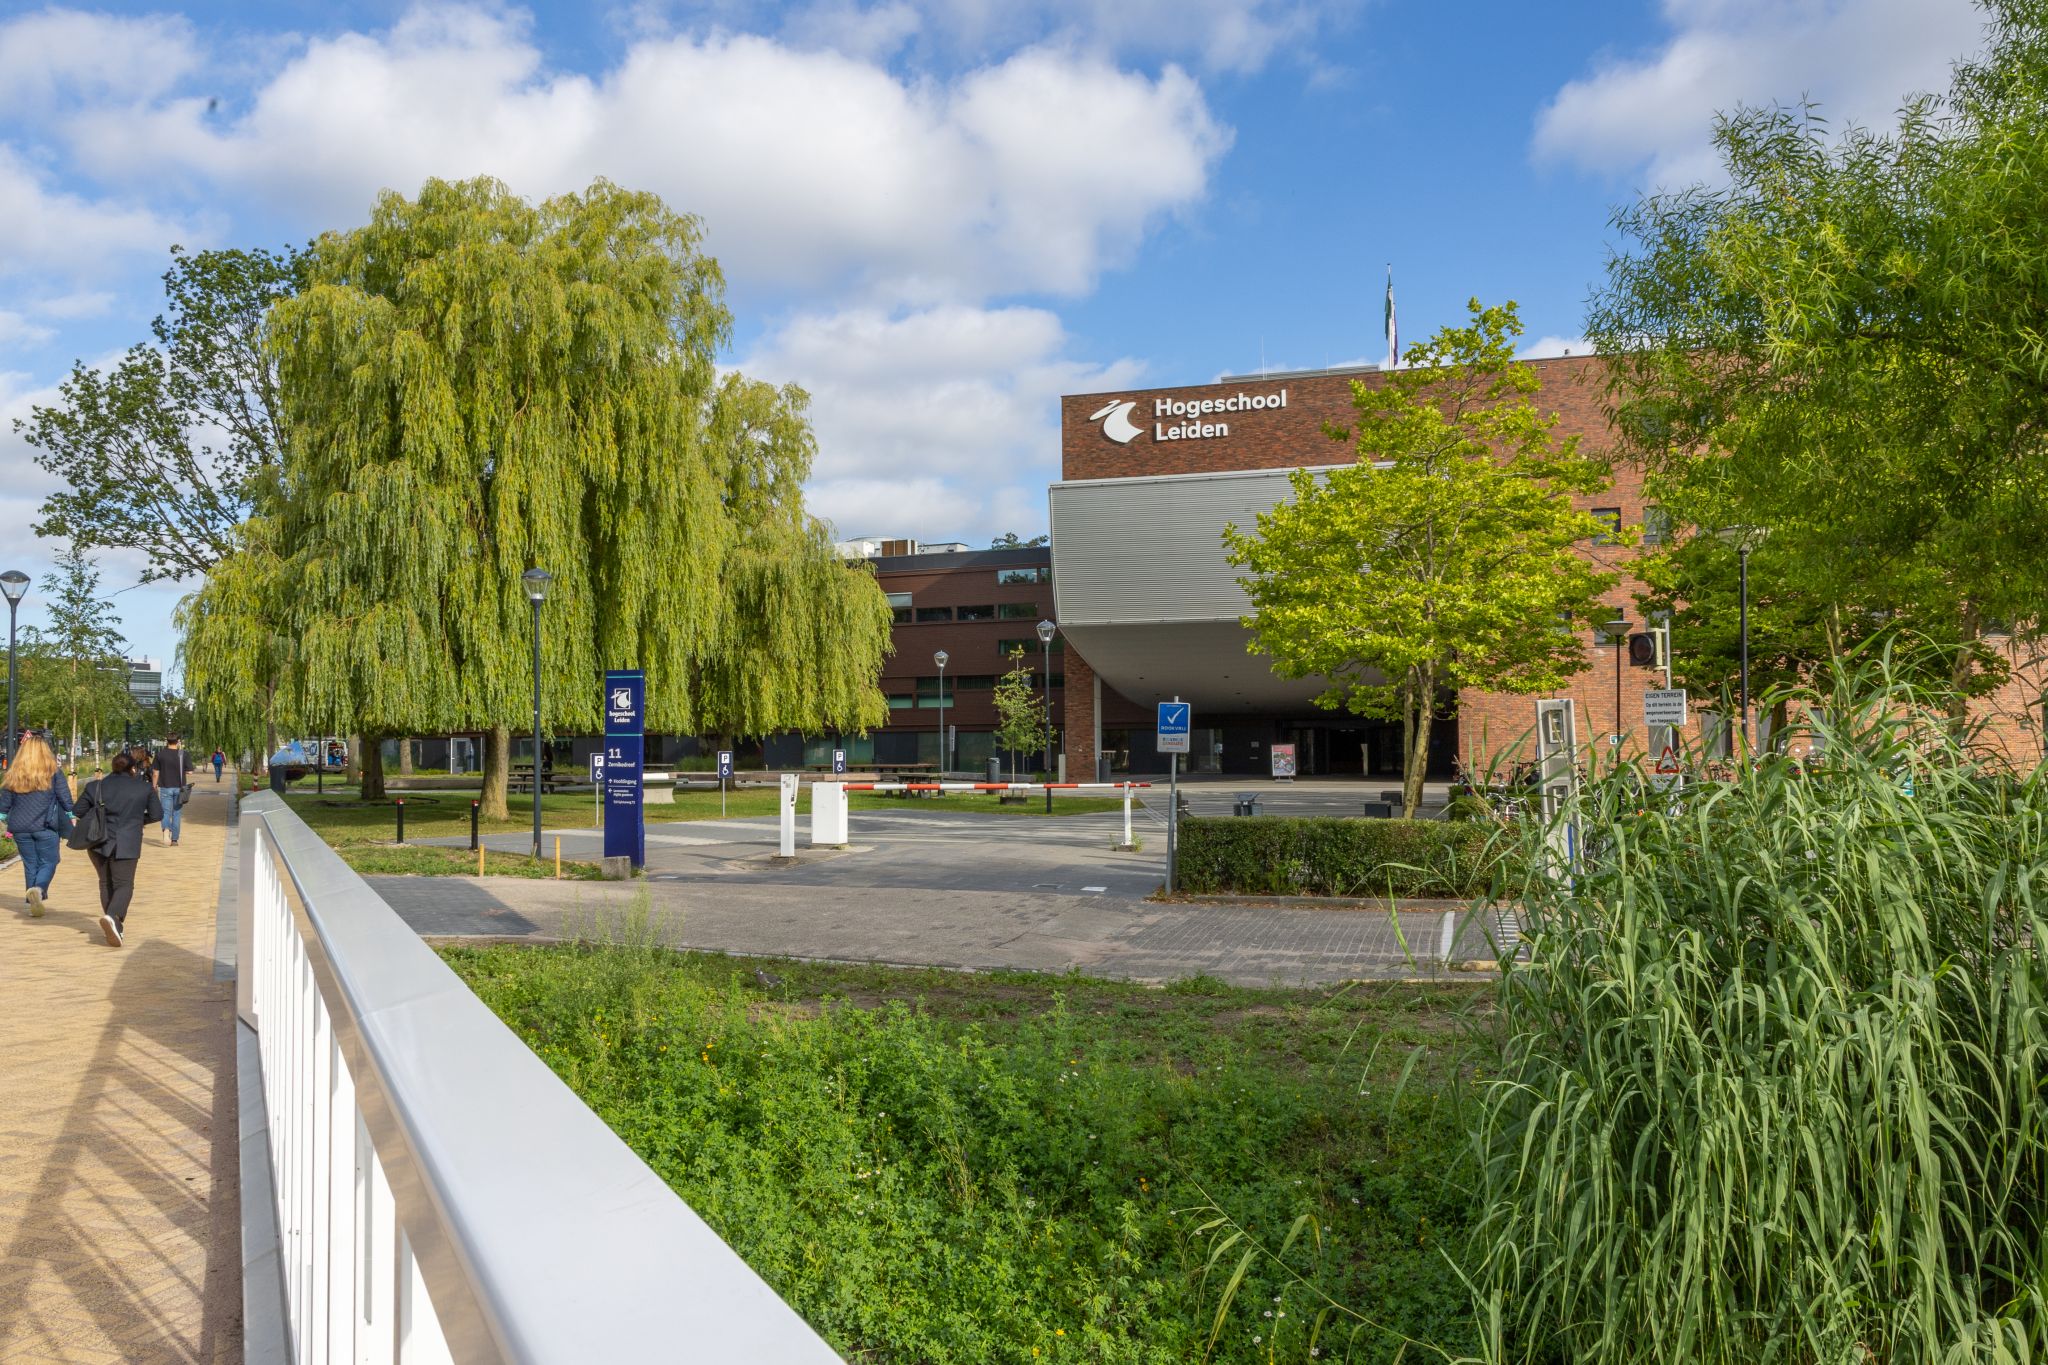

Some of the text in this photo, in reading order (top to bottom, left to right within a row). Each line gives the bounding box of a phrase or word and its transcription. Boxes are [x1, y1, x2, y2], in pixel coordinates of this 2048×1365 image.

[1155, 389, 1287, 418] Hogeschool
[1155, 421, 1229, 441] Leiden
[608, 748, 621, 758] 11
